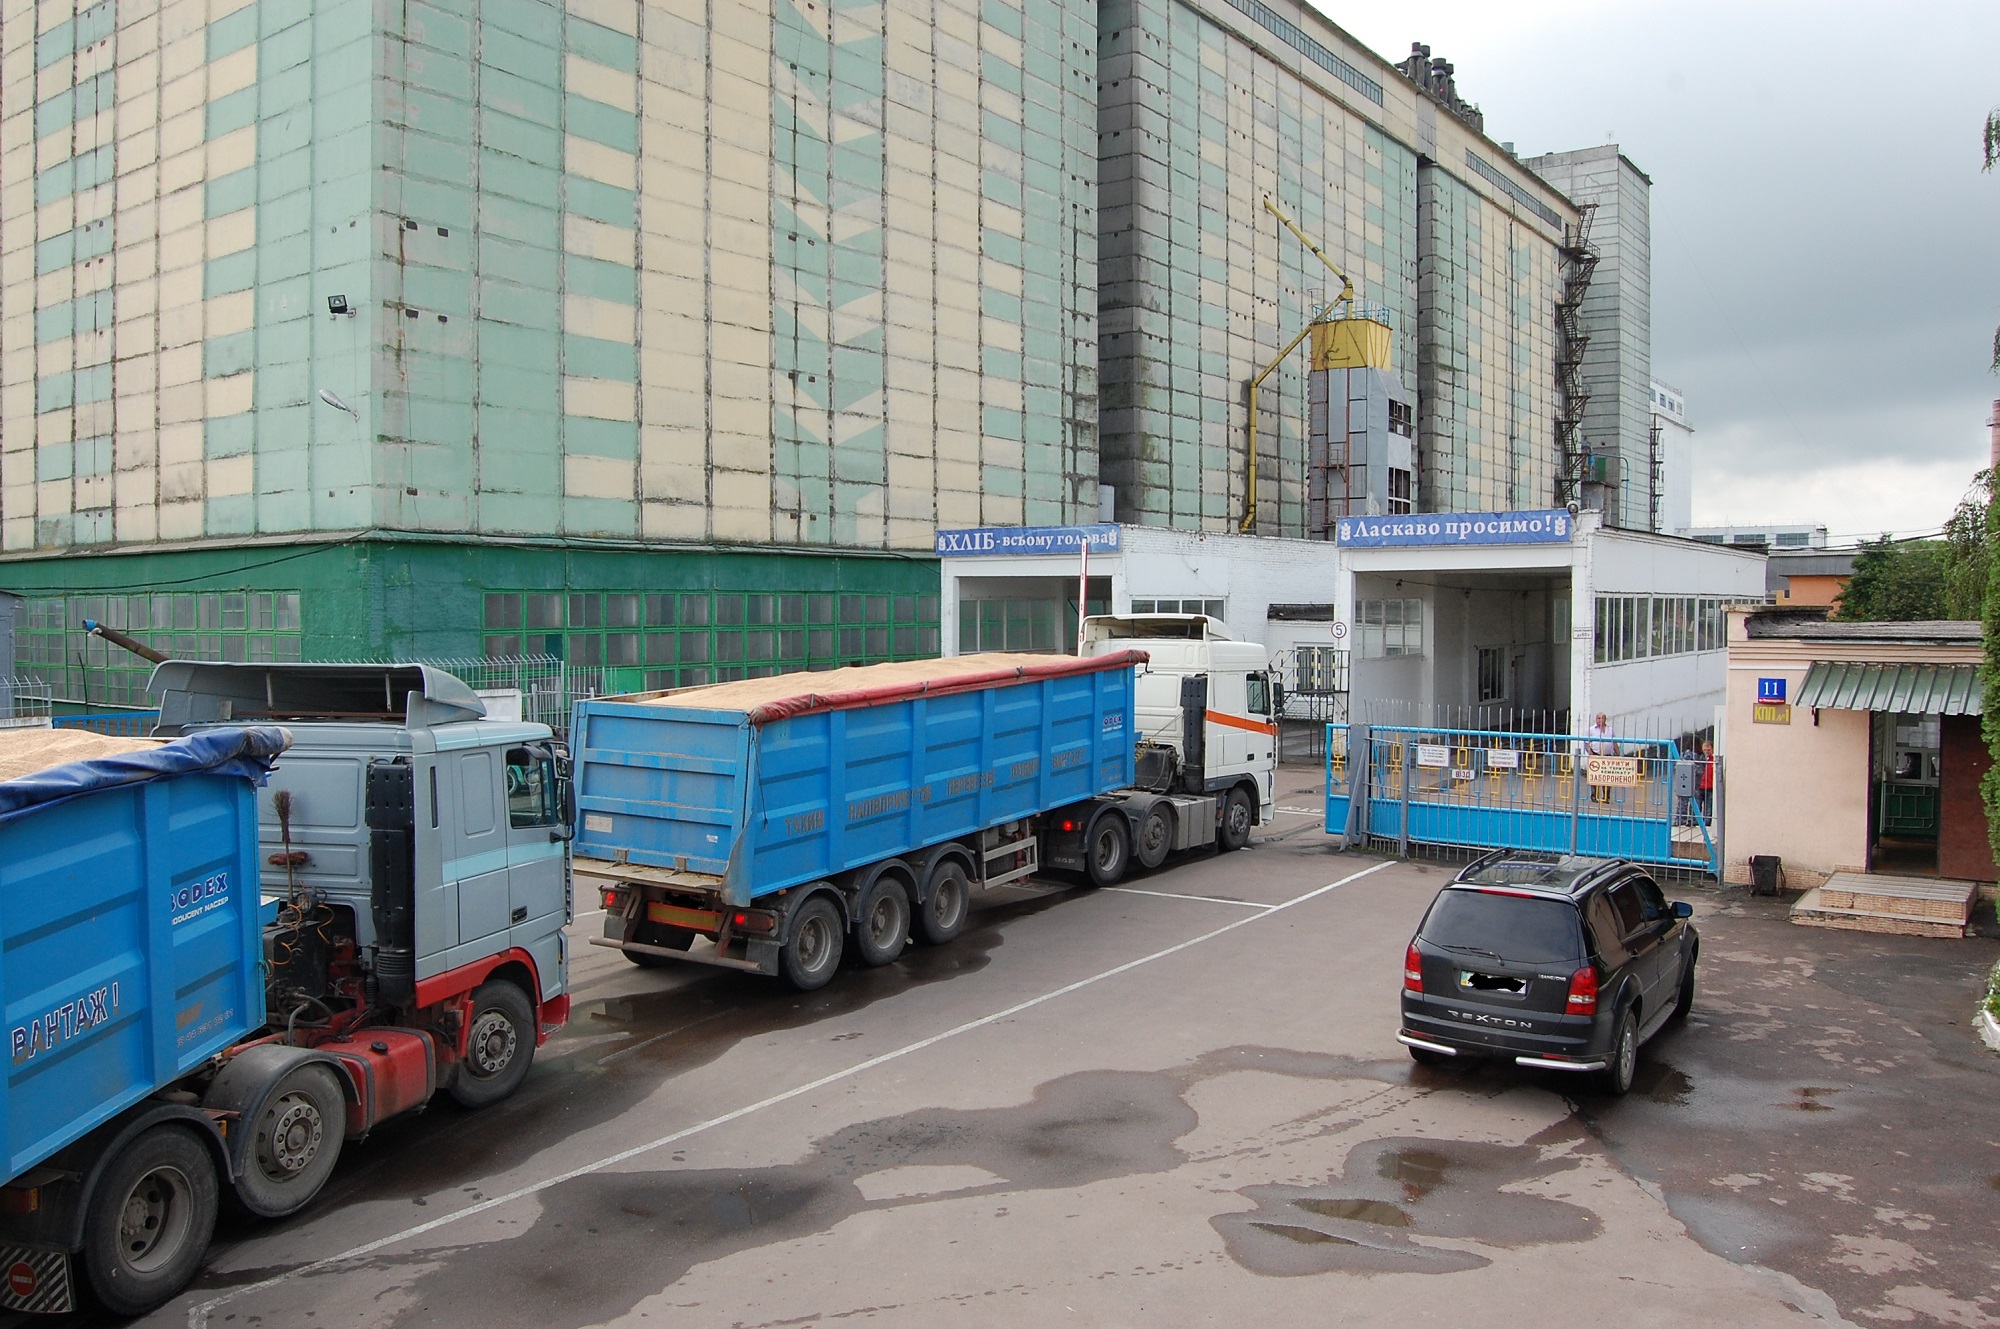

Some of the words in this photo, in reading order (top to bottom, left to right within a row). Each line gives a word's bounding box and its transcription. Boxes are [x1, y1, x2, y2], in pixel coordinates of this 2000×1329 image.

[1353, 520, 1440, 537] Ласкаво
[1445, 515, 1551, 540] просимо!
[946, 532, 994, 551] ХЛІБ
[1002, 535, 1054, 550] всьому
[1335, 625, 1343, 636] 5
[1764, 681, 1779, 696] 11
[1755, 706, 1776, 721] КПП
[1590, 774, 1635, 784] ЗАБОРОНЕНО!
[172, 906, 203, 926] ODUCENT
[1447, 1009, 1532, 1028] REXTON
